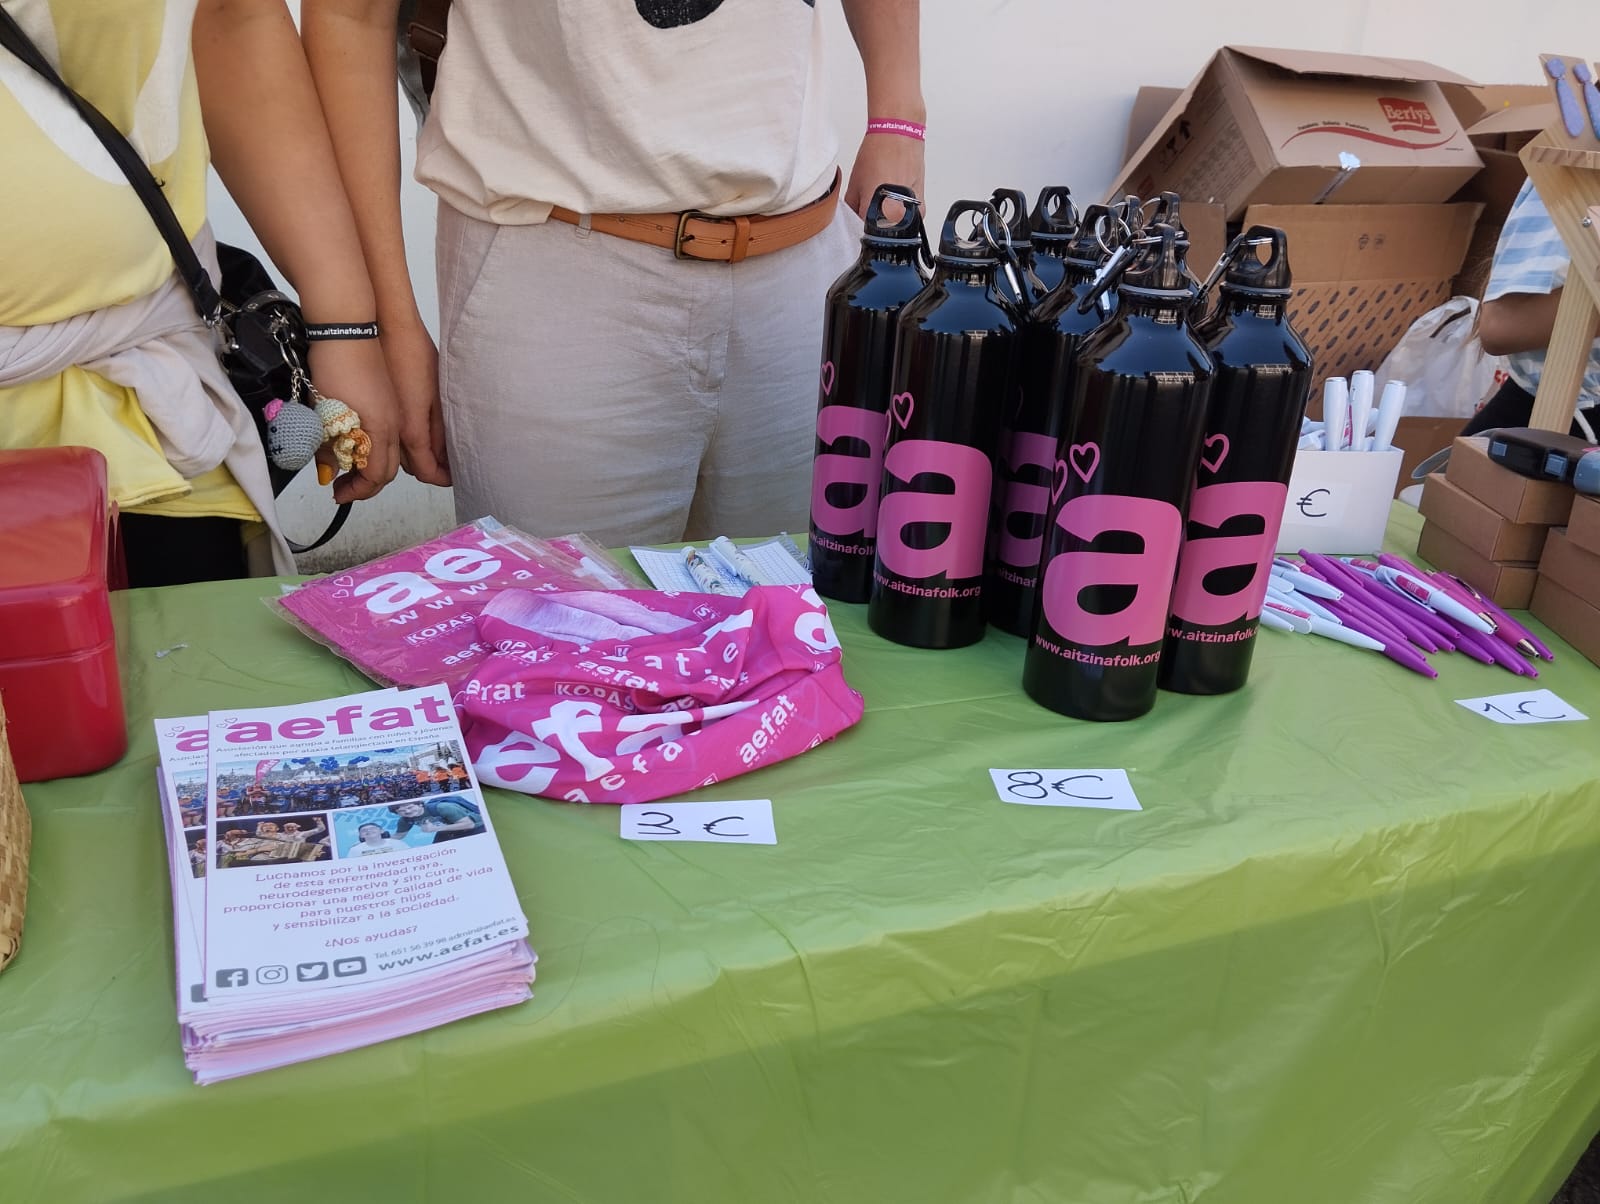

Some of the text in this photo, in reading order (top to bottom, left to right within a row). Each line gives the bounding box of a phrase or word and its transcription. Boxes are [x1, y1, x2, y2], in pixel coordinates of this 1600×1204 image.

[1383, 104, 1431, 128] Berlys
[811, 405, 888, 539] a
[876, 439, 993, 580] a
[1042, 494, 1182, 648] a
[1168, 481, 1288, 627] a
[408, 612, 475, 644] KOPAS
[1034, 633, 1162, 667] www.aitzinafolk.org
[224, 695, 450, 744] aefat
[740, 694, 796, 764] aefat
[637, 811, 750, 838] 3 €
[256, 869, 326, 882] Luchamos
[331, 867, 353, 876] por
[358, 864, 369, 872] la
[373, 847, 457, 869] investigación
[273, 861, 444, 889] de esta enfermedad rara.
[223, 865, 494, 914] proporcionar una mejor calidad de vida
[259, 866, 460, 901] neurodegenerativa y sin cura.
[272, 894, 460, 931] y sensibilizar a la sociedad.
[300, 890, 432, 919] para nuestros hijos
[324, 925, 419, 948] ¿Nos ayudas?
[378, 925, 520, 971] www.aefat.es
